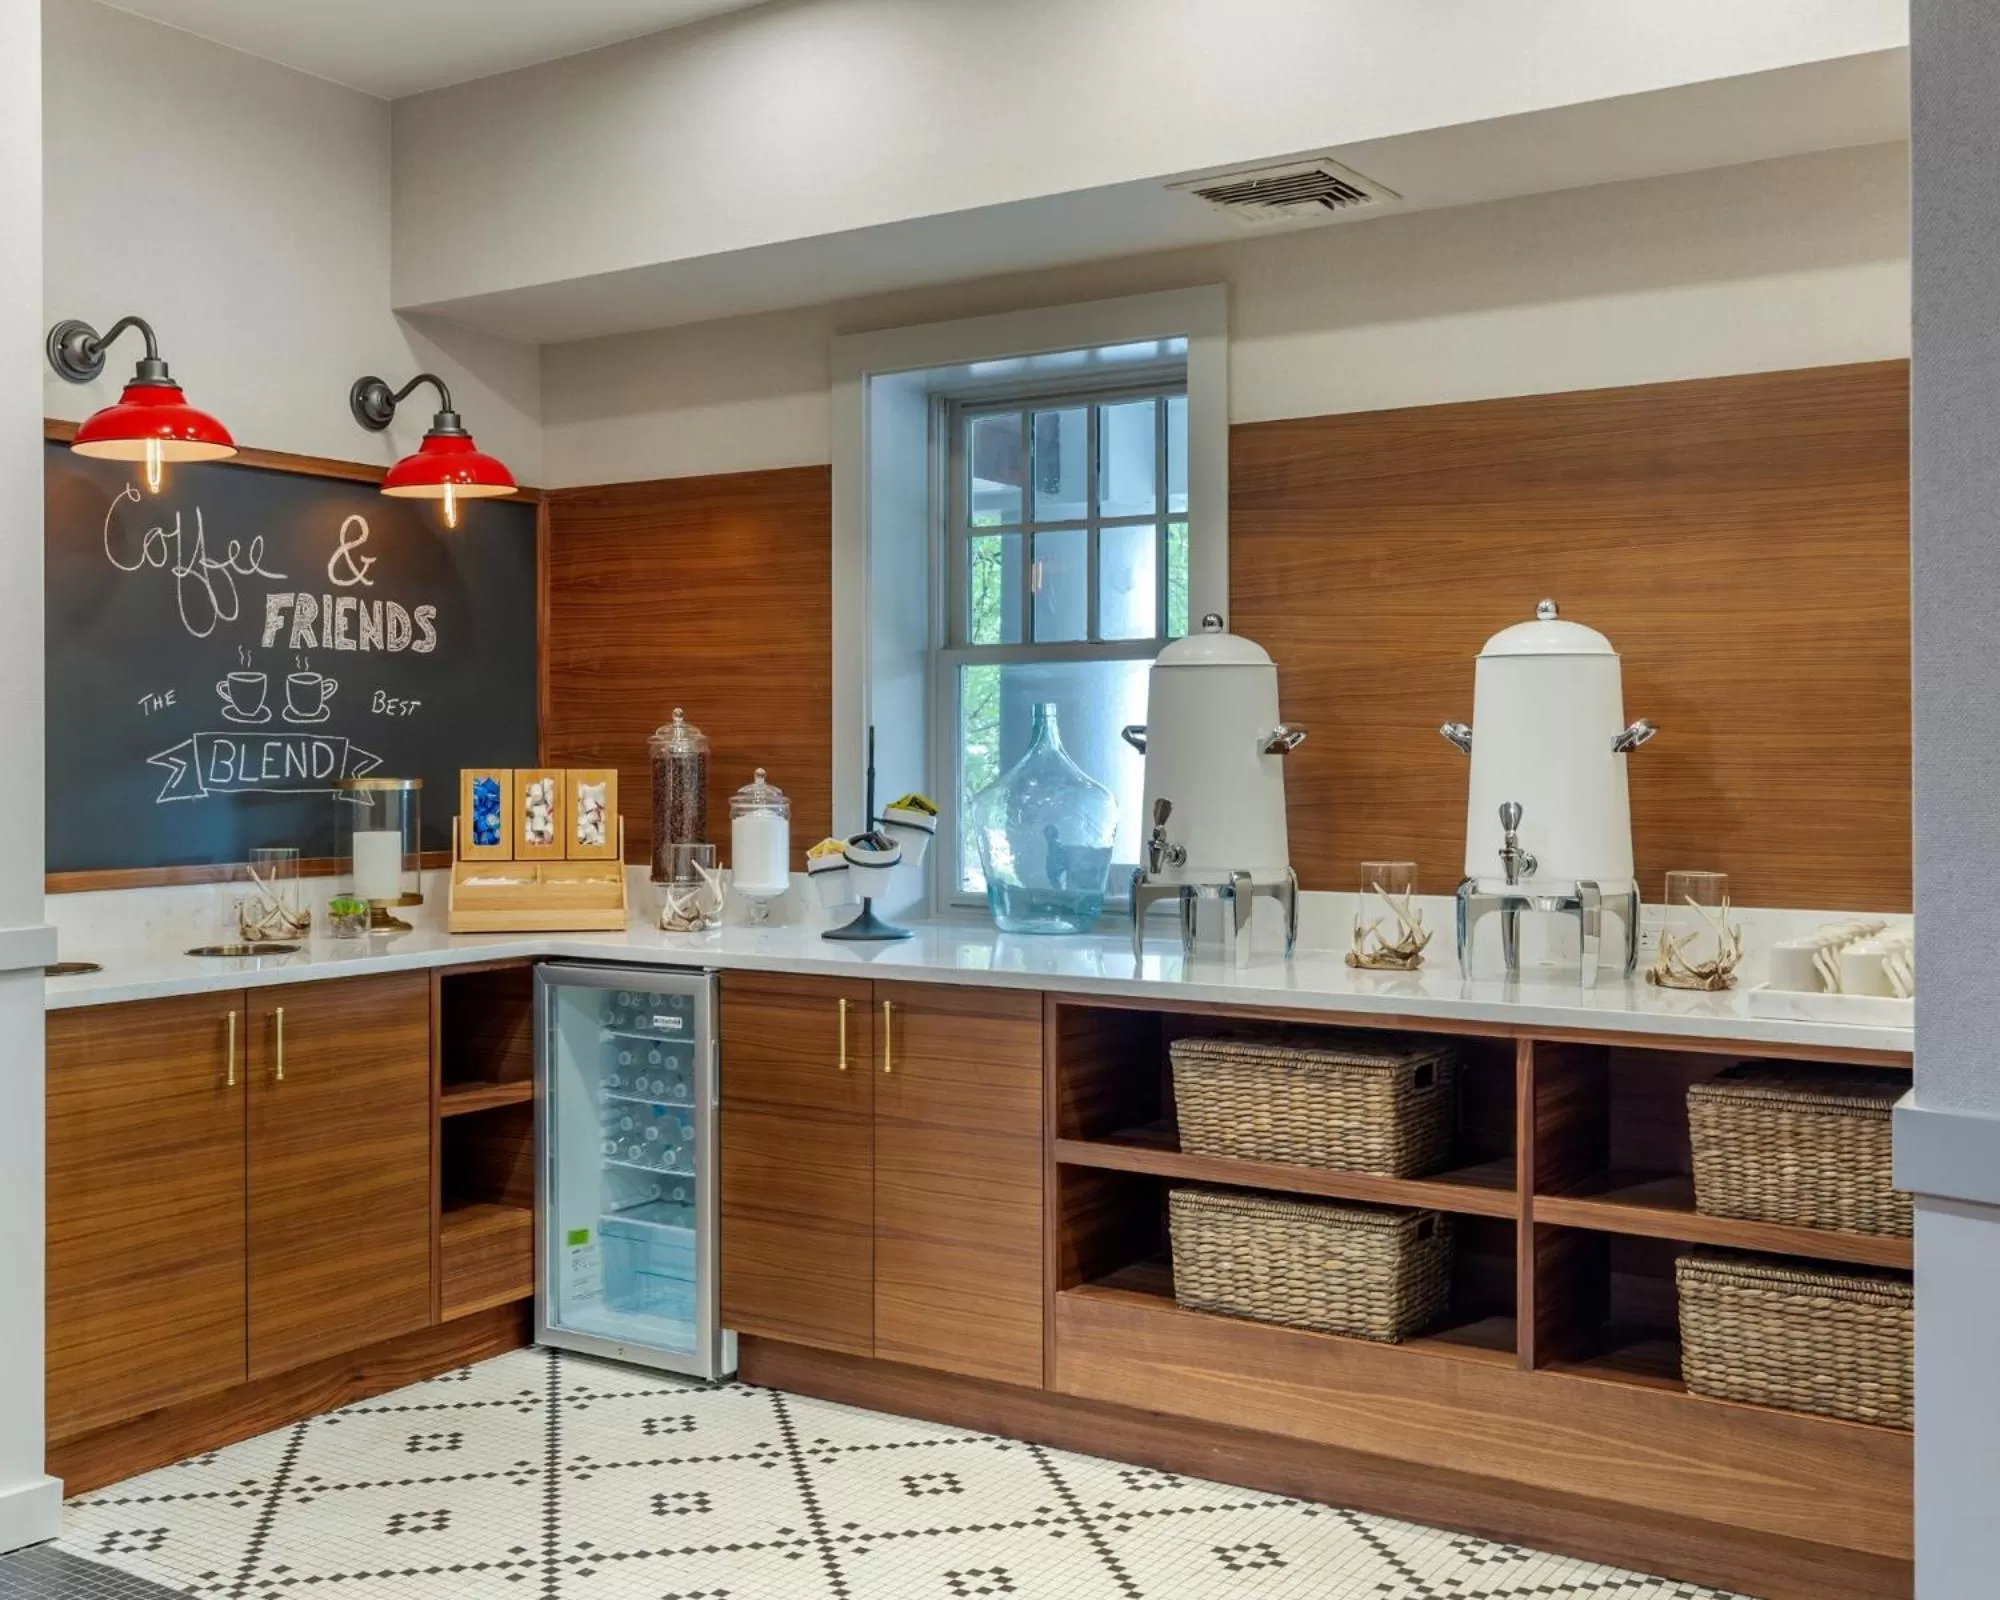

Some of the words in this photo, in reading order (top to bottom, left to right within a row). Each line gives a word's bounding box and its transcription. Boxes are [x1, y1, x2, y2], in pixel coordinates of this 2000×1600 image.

[104, 482, 288, 638] Coffee
[327, 514, 377, 587] &
[261, 592, 438, 653] FRIENDS
[138, 689, 177, 717] THE
[371, 690, 422, 717] BEST
[208, 739, 335, 783] BLEND
